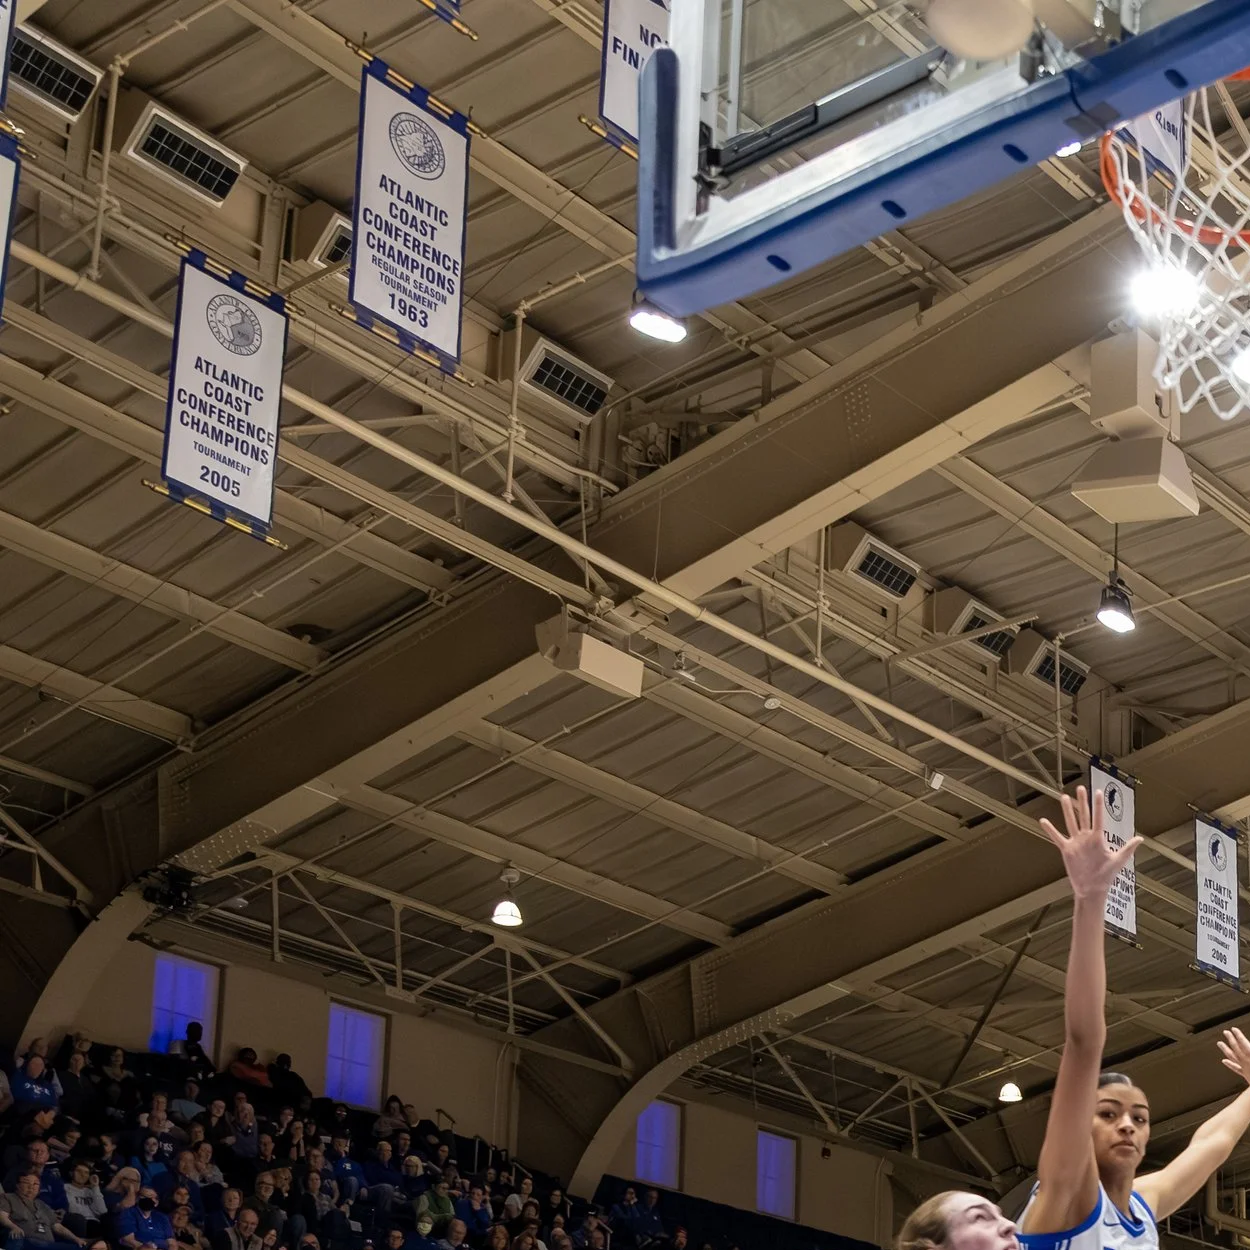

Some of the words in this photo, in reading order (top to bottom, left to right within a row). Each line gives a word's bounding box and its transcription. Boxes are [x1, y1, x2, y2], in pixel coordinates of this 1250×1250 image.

[379, 174, 449, 227] ATLANTIC
[389, 201, 437, 242] COAST
[362, 207, 460, 278] CONFERENCE
[366, 231, 456, 296] CHAMPIONS
[371, 254, 411, 286] REGULAR
[413, 279, 447, 305] SEASON
[379, 271, 438, 313] TOURNAMENT
[388, 292, 429, 330] 1963
[194, 355, 264, 402] ATLANTIC
[203, 381, 252, 417] COAST
[177, 388, 275, 449] CONFERENCE
[180, 410, 269, 466] CHAMPIONS
[193, 440, 251, 476] TOURNAMENT
[200, 465, 241, 498] 2005
